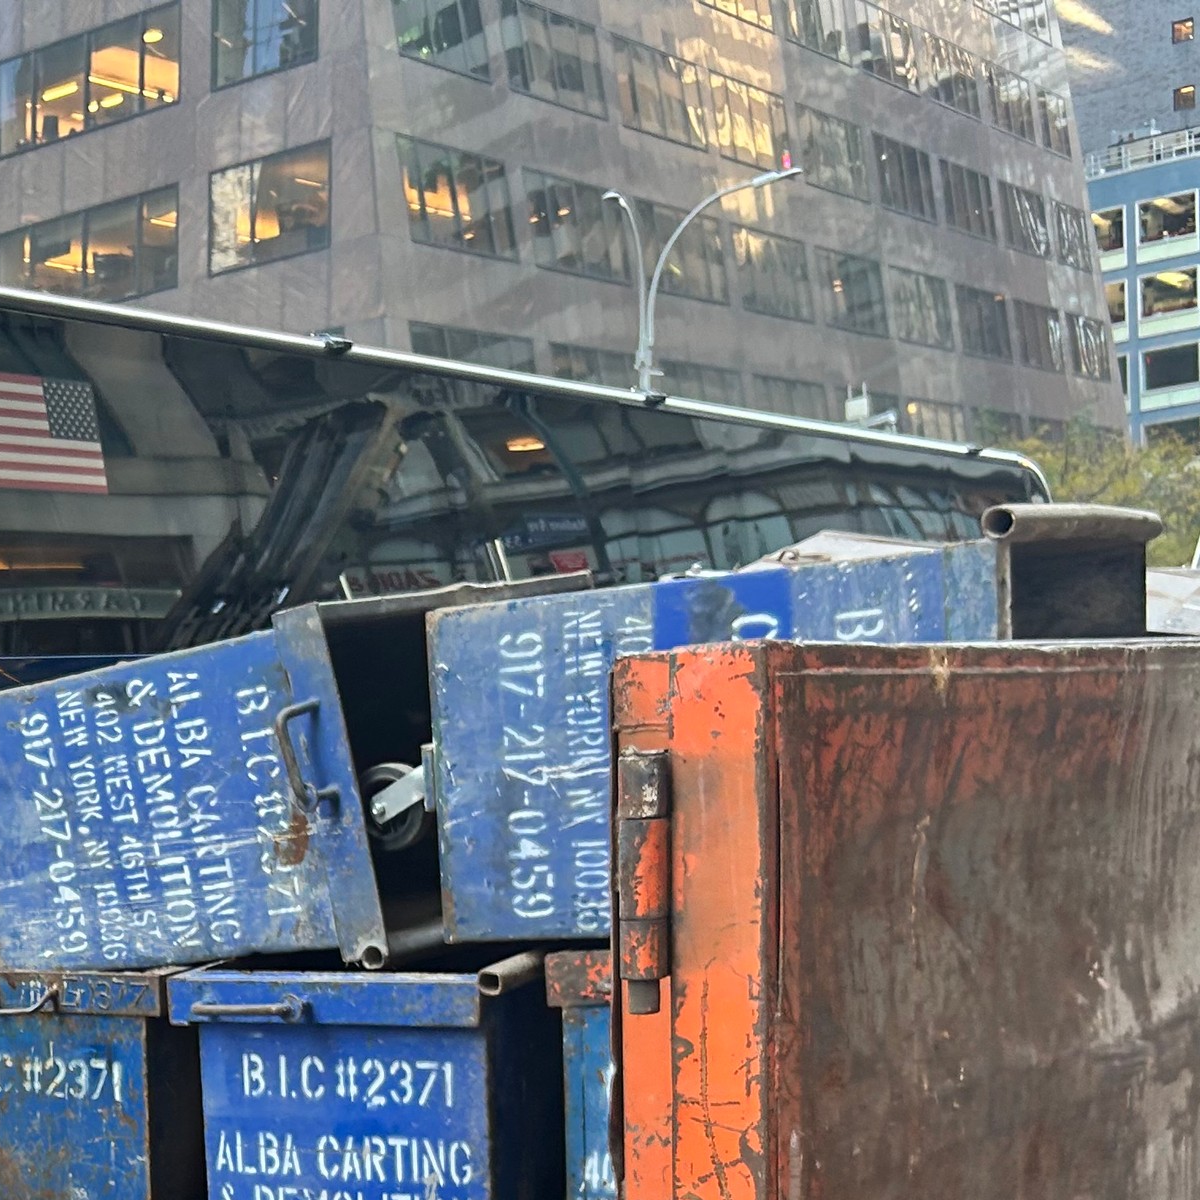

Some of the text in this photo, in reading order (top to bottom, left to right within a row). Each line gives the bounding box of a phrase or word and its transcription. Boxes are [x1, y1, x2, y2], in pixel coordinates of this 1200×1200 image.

[55, 690, 89, 747] NEW
[95, 691, 123, 745] 402
[166, 670, 212, 769] ALBA
[102, 753, 140, 825] WEST
[499, 631, 555, 919] 917-217-0459
[21, 712, 89, 955] 917-217-0459
[125, 678, 202, 948] & DEMOLITION
[117, 835, 152, 901] 46TH
[335, 1056, 453, 1109] #2371
[216, 1130, 473, 1188] ALBA CARTING
